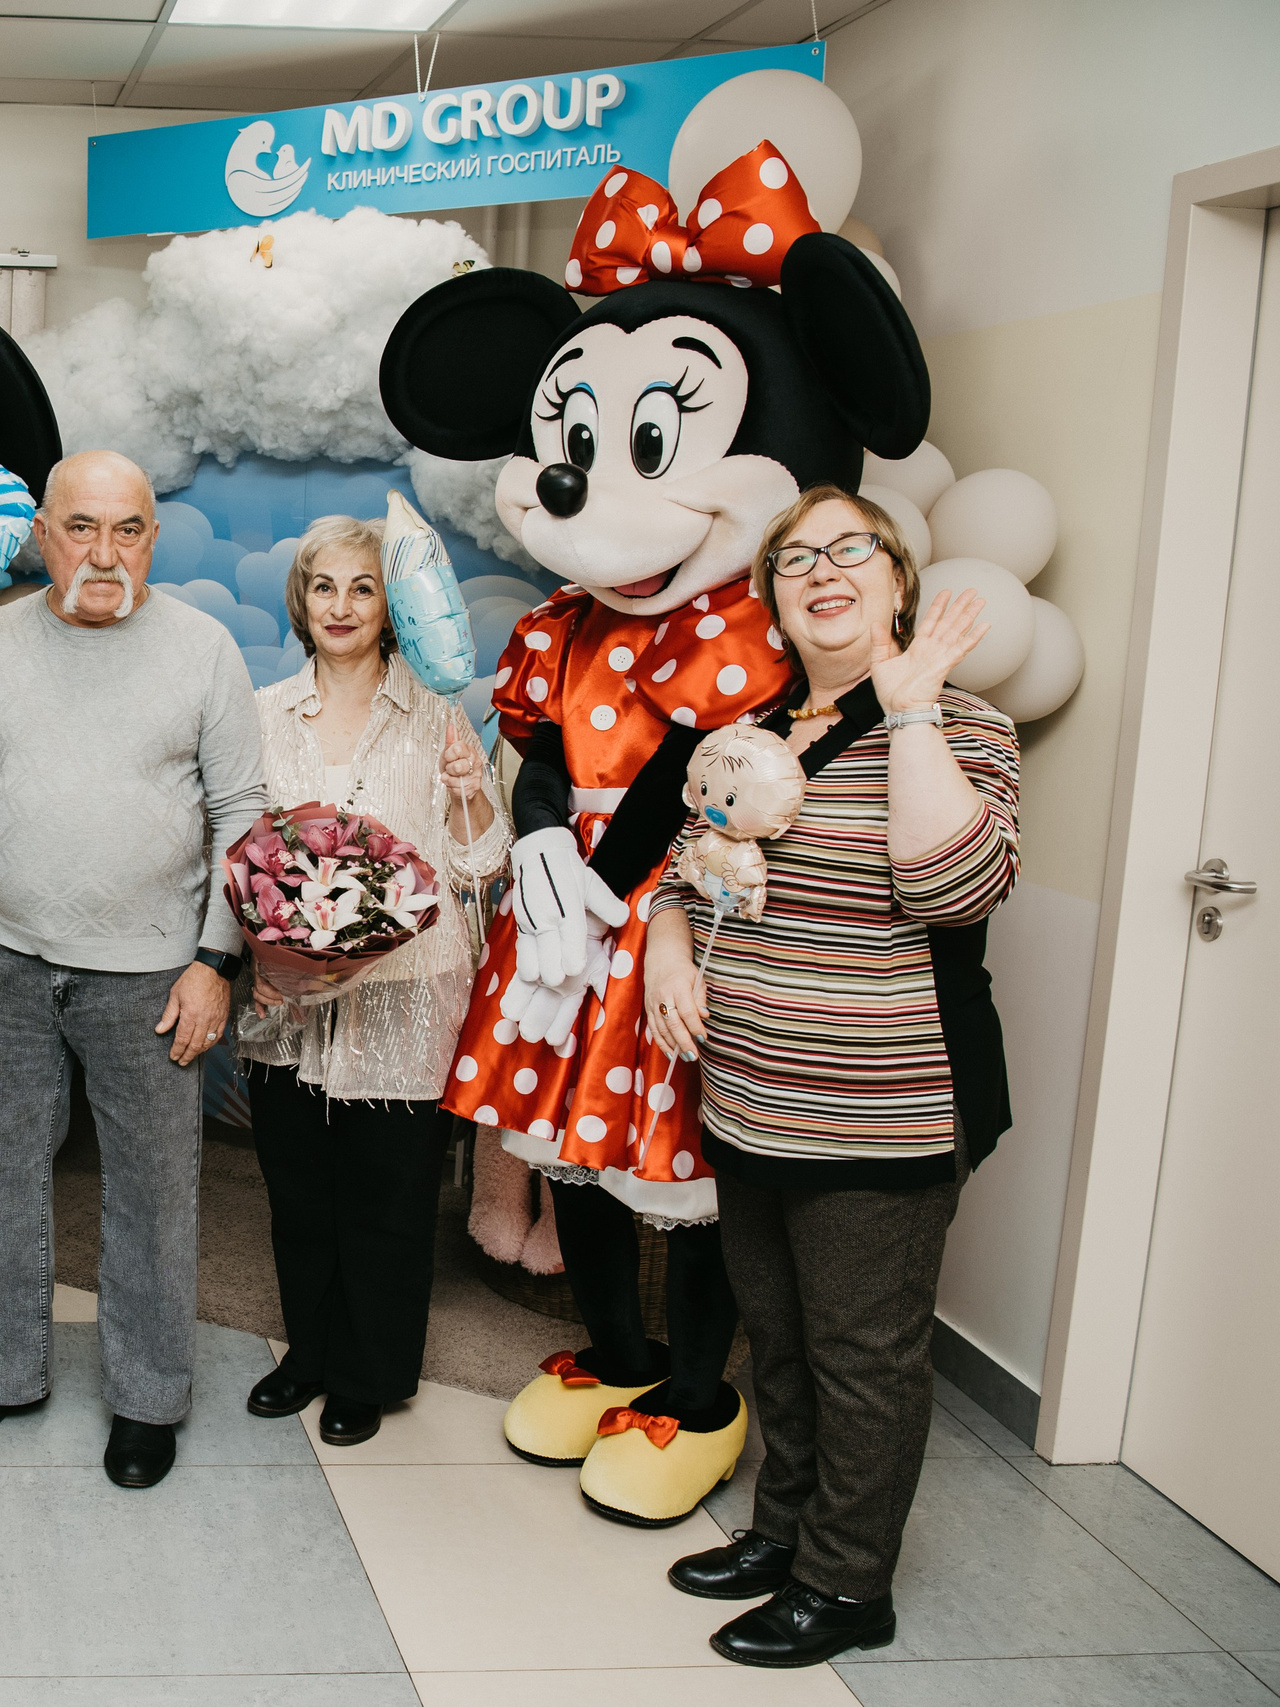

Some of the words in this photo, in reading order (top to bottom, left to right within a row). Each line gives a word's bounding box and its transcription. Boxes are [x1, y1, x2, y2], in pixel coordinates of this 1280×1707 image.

[320, 101, 414, 157] MD
[422, 73, 626, 146] GROUP
[327, 153, 481, 191] КЛИНИЧЕСКИЙ
[487, 143, 621, 176] ГОСПИТАЛЬ
[407, 615, 417, 626] a
